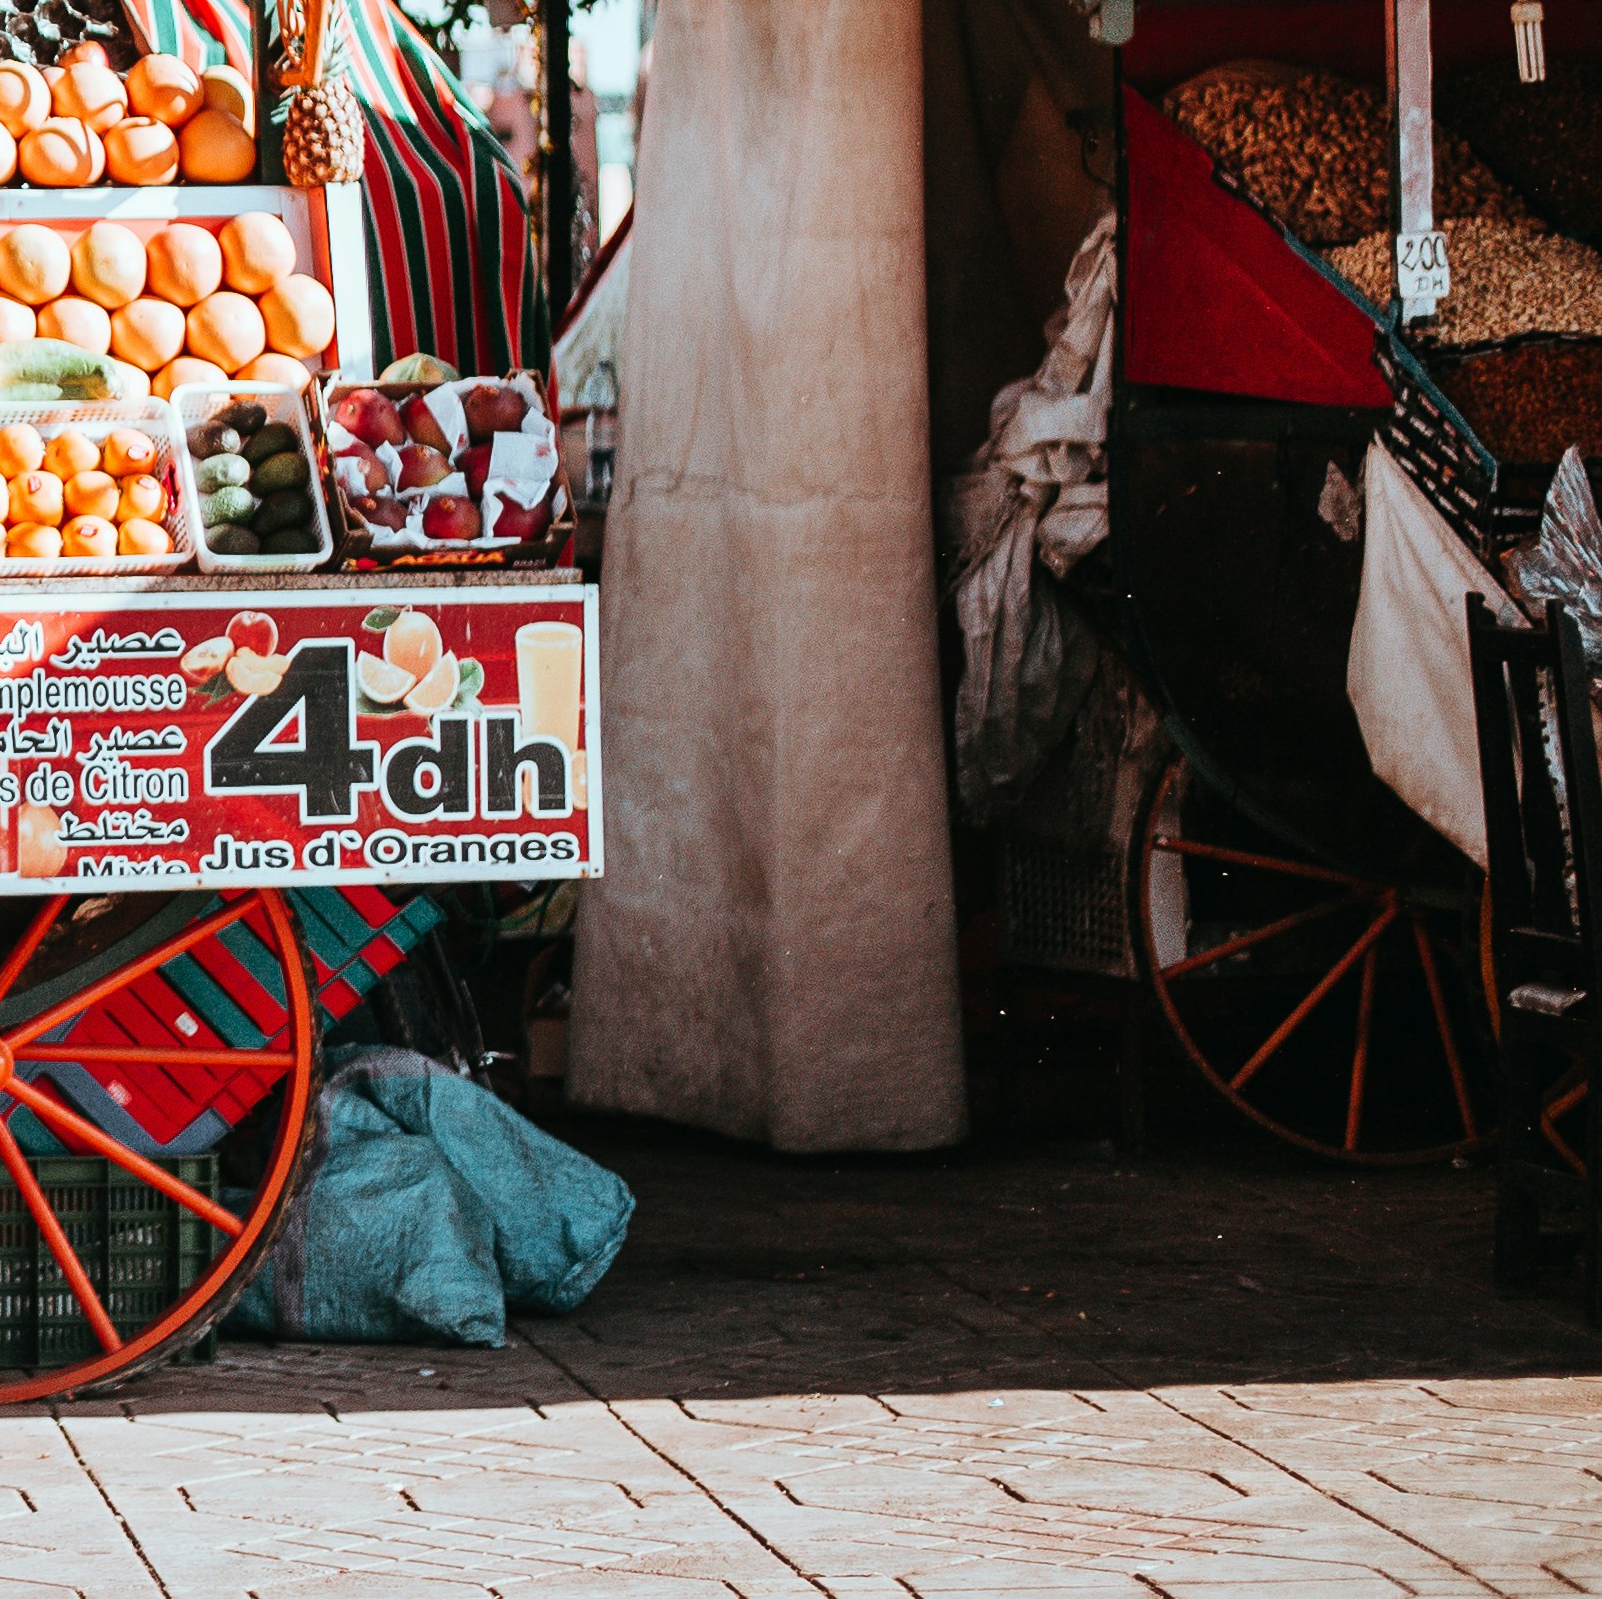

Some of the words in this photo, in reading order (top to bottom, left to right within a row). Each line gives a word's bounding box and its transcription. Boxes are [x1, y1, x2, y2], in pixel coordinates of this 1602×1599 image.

[1400, 235, 1448, 272] 200
[55, 631, 186, 667] عصير
[83, 727, 186, 762] عصير
[28, 765, 71, 802] de
[85, 764, 185, 801] Citron
[56, 811, 186, 842] مختلط
[205, 840, 290, 871] Jus
